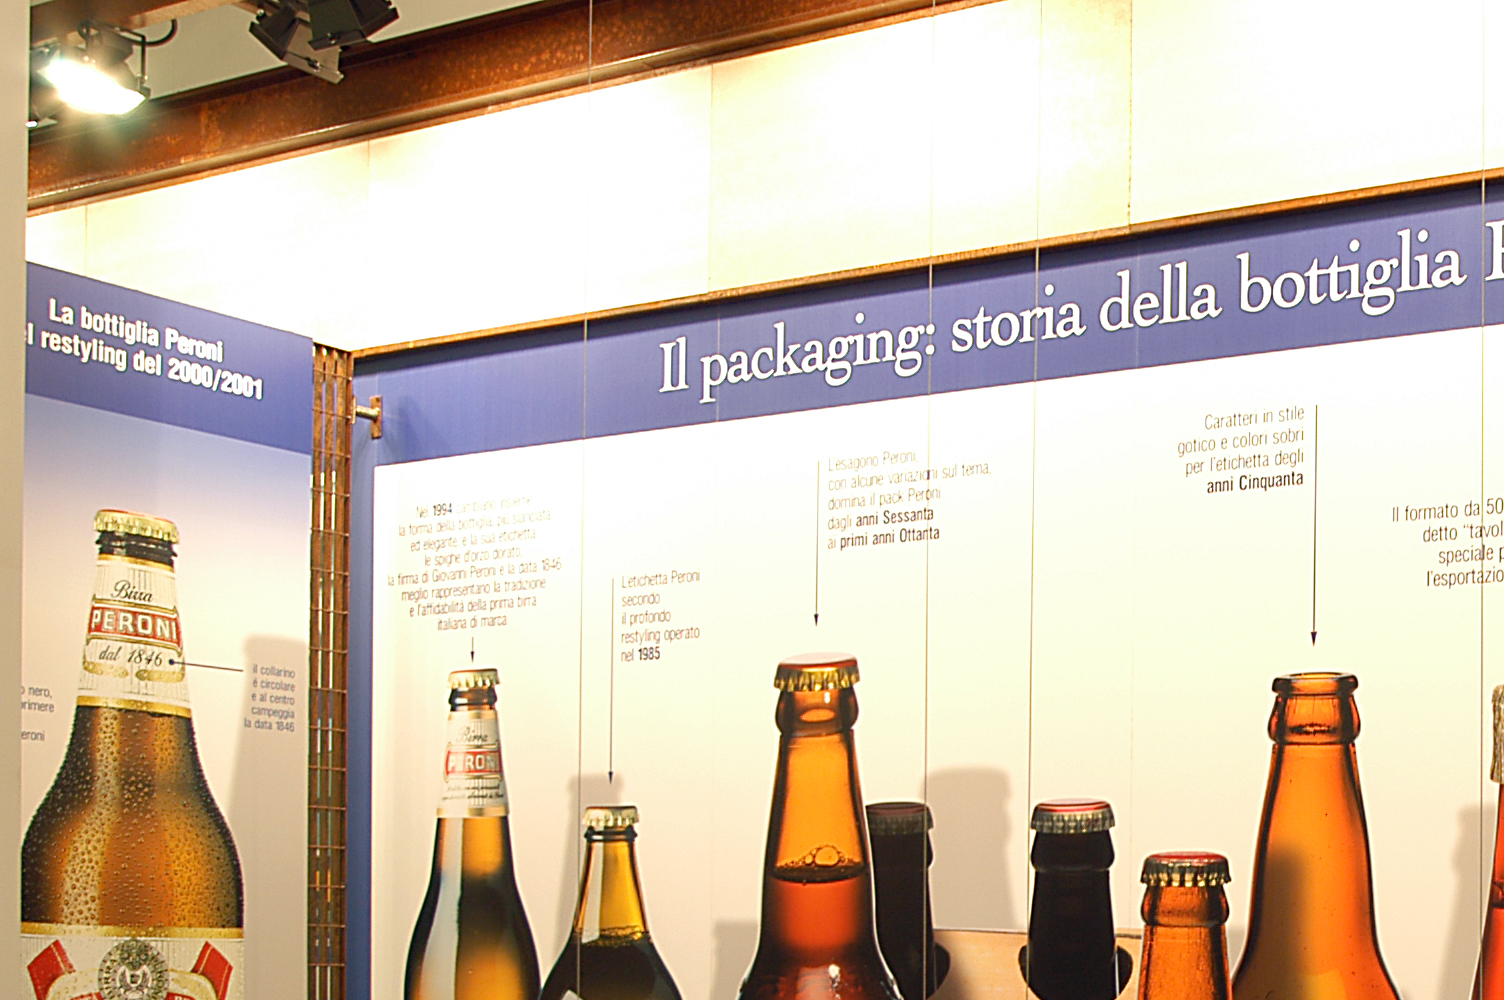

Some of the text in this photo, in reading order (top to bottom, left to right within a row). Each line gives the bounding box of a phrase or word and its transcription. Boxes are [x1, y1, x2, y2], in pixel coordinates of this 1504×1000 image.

[659, 338, 688, 392] Il
[700, 311, 935, 403] packaging:
[951, 284, 1086, 352] storia
[1099, 269, 1221, 331] della
[1238, 231, 1466, 315] bottiglia
[49, 298, 223, 362] La bottiglia Peroni
[41, 330, 263, 400] restyling del 2000/2001
[1204, 405, 1304, 430] Caratteri in stile
[1177, 426, 1304, 458] gotico e colori sobri
[1185, 448, 1304, 479] per l'etichetta degli
[1207, 470, 1304, 494] anni Cinquanta
[827, 507, 934, 532] dagli anni Sessanta
[1392, 506, 1400, 522] Il
[1404, 501, 1458, 522] formato
[1463, 500, 1481, 518] da
[1486, 497, 1504, 515] 50
[827, 526, 940, 551] ai primi anni Ottanta
[1422, 525, 1458, 543] detto
[1438, 544, 1494, 566] speciale
[621, 593, 660, 607] secondo
[91, 609, 177, 640] PERONI
[621, 626, 700, 647] restyling operato
[99, 645, 163, 667] dal 1846
[621, 646, 660, 662] nel 1985
